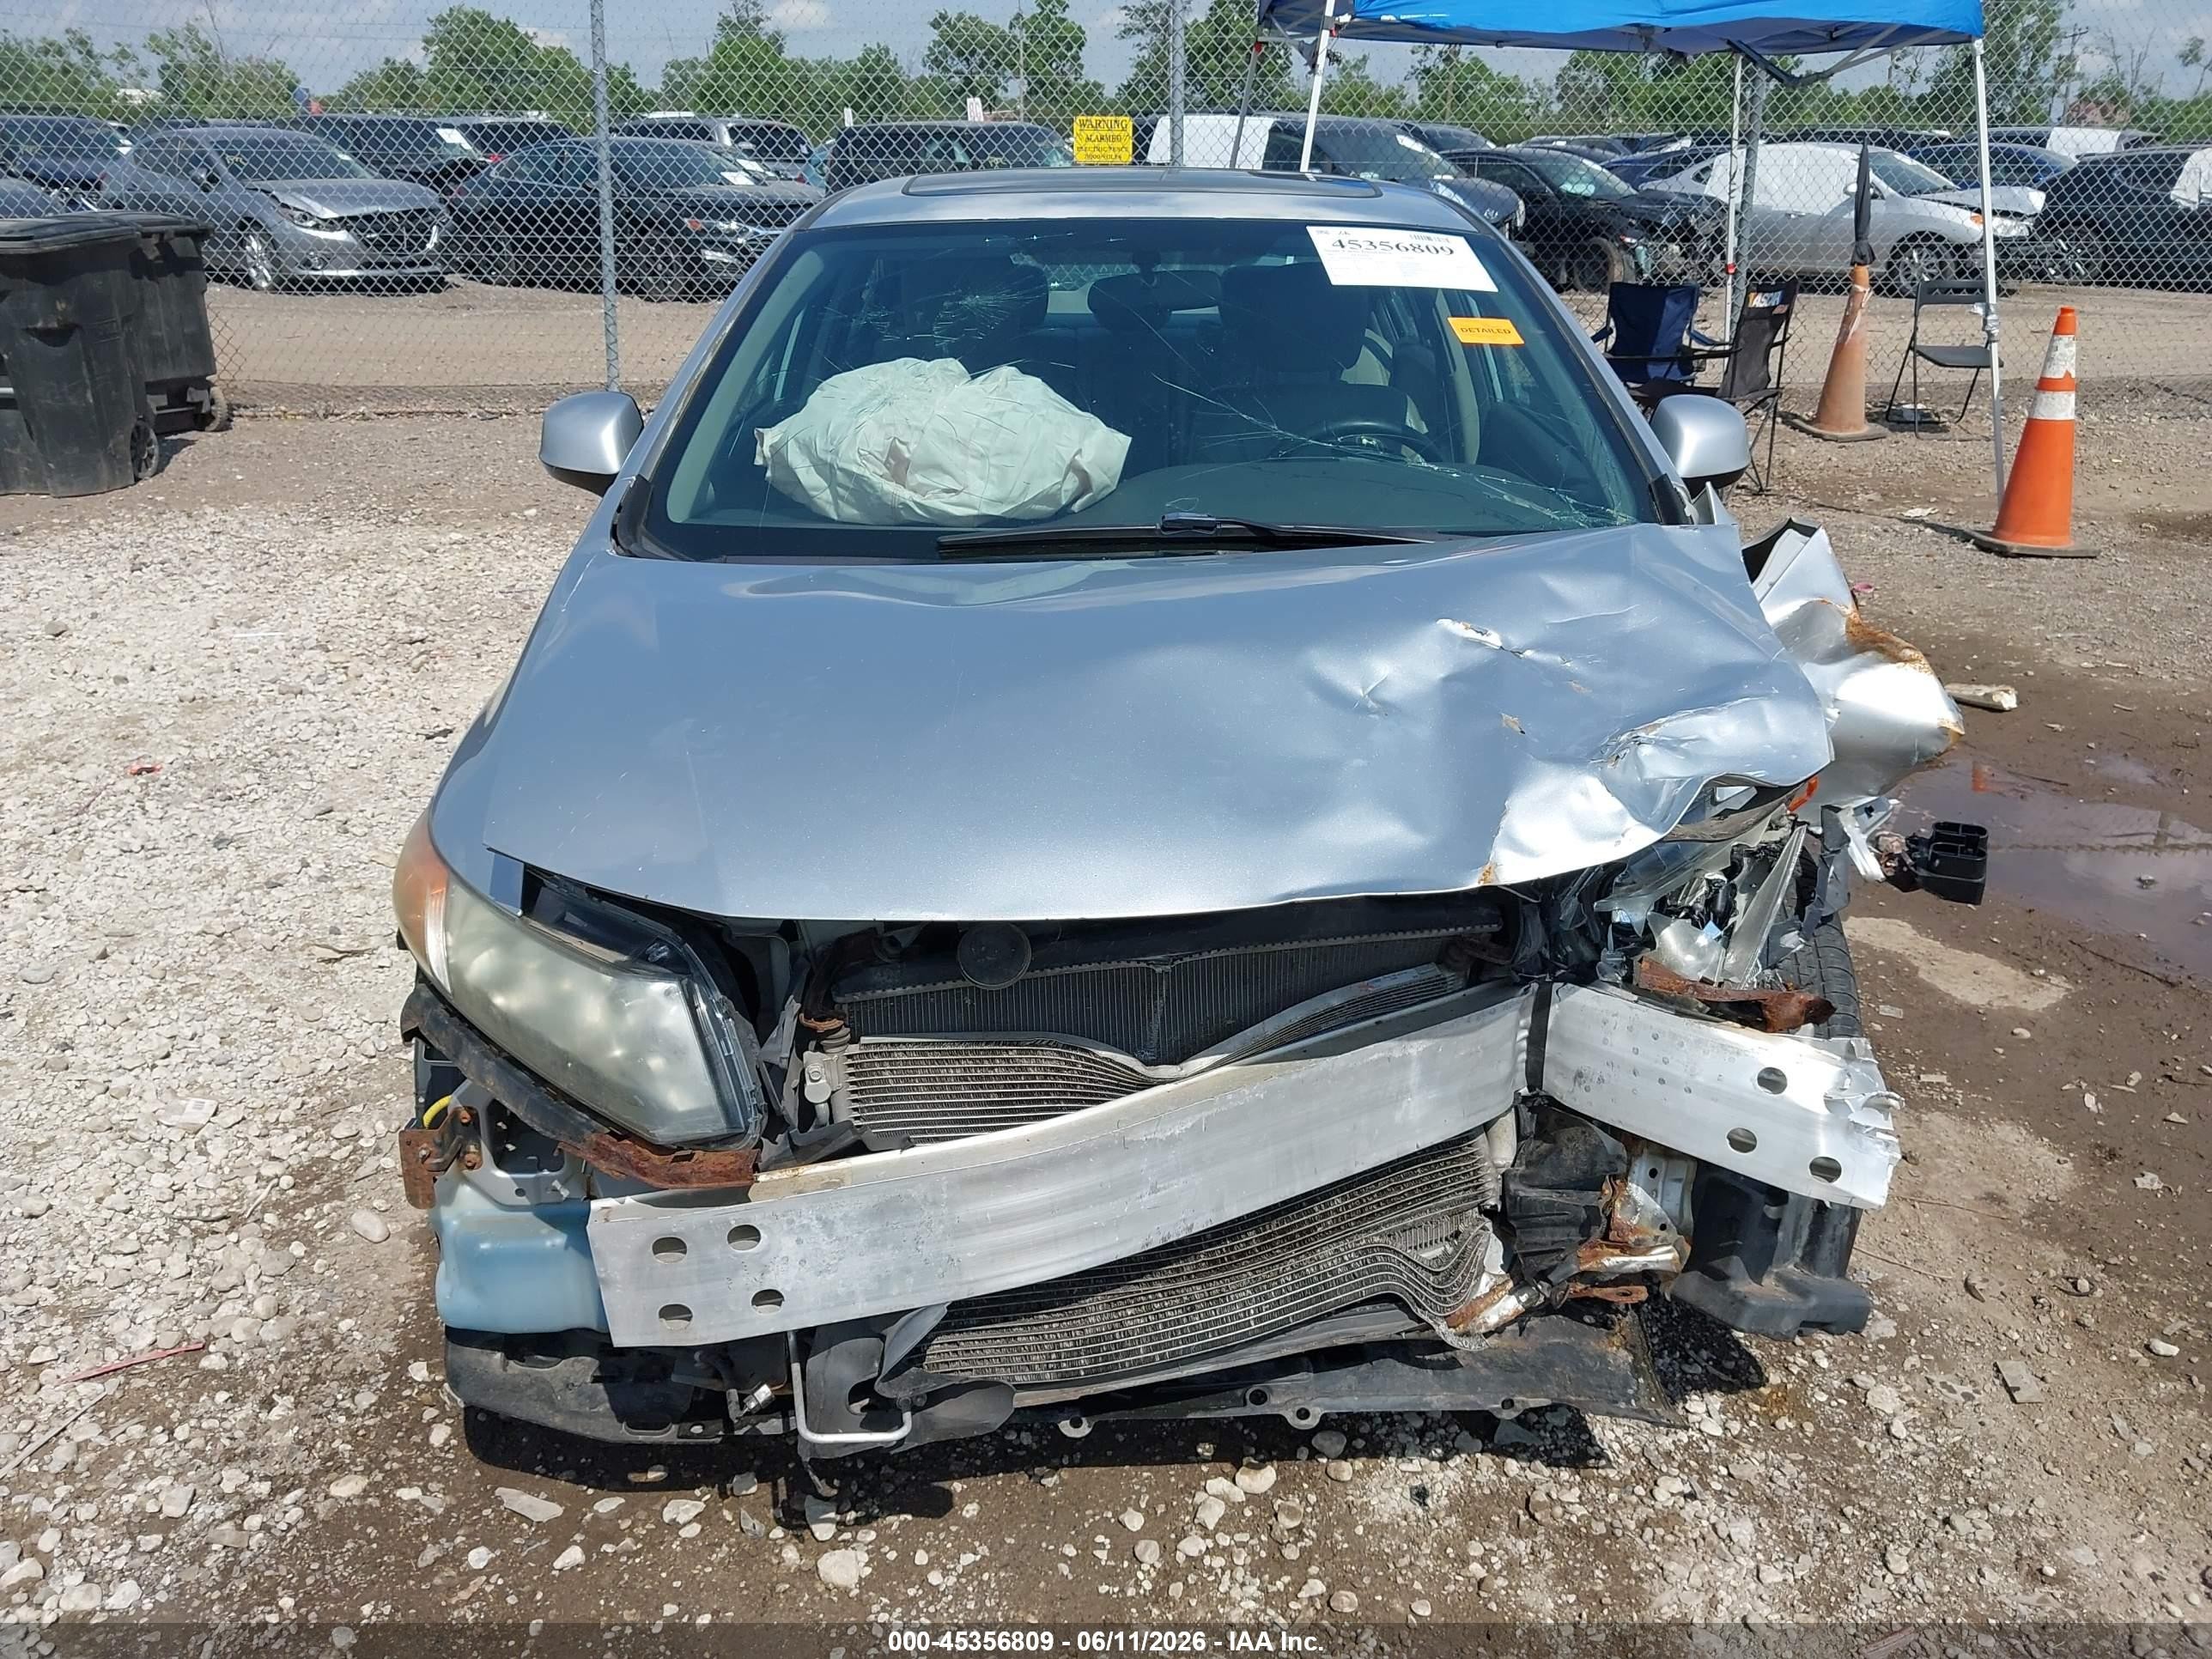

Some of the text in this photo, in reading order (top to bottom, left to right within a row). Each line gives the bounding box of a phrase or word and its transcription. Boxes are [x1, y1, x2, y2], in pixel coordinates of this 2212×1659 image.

[1079, 118, 1127, 129] WARNING
[1085, 134, 1122, 143] ALARMED
[1331, 239, 1455, 256] 45356809
